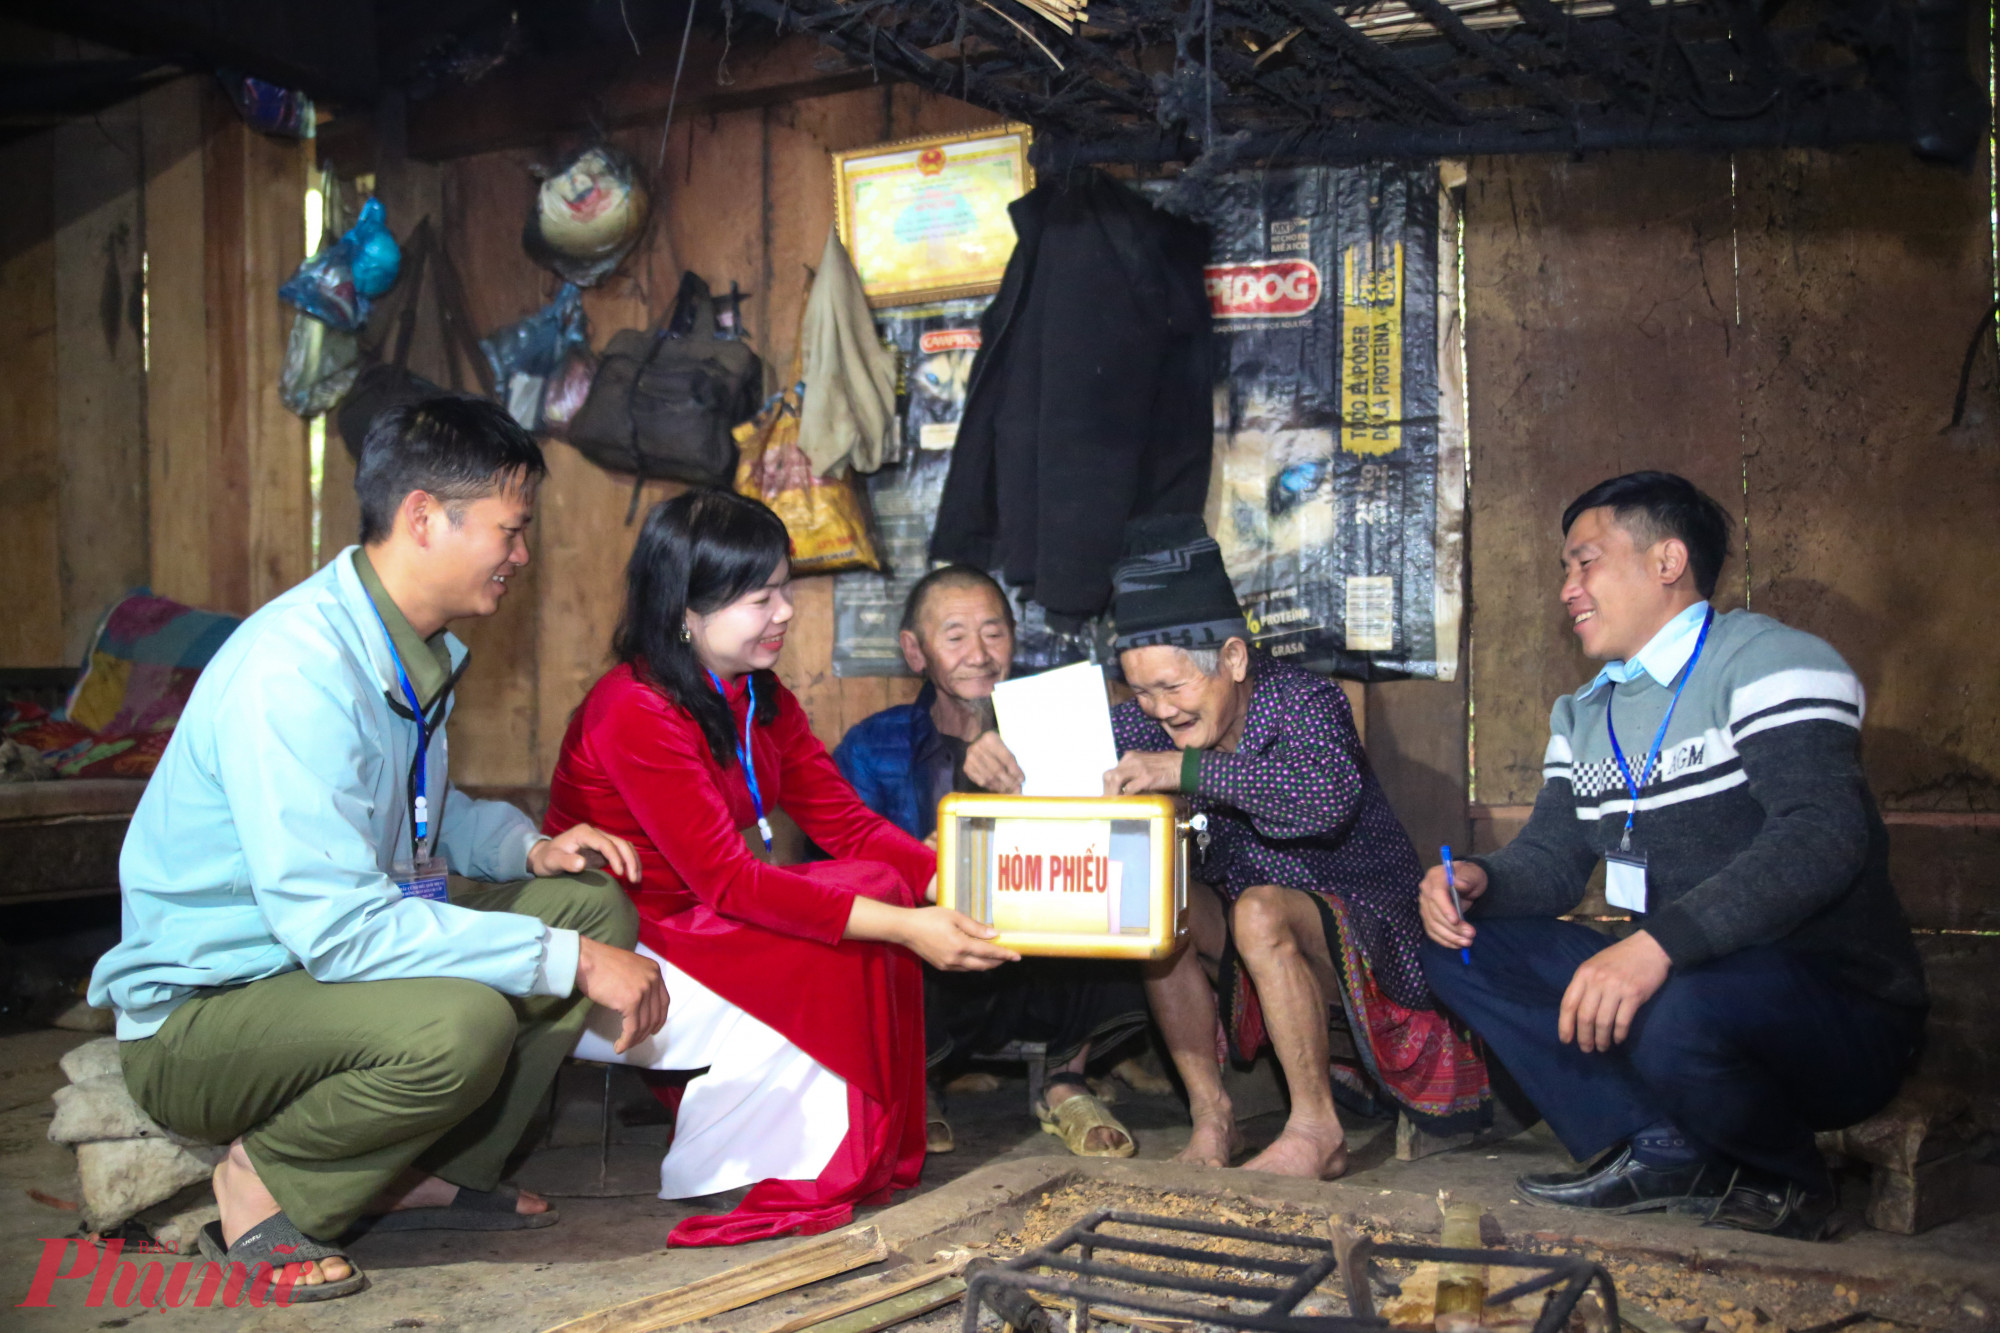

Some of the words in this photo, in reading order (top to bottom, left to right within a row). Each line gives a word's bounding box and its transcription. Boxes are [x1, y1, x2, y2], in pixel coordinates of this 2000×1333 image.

[1377, 267, 1394, 301] 10%
[1351, 325, 1370, 376] PODER
[1271, 641, 1306, 658] GRASA
[1667, 743, 1706, 775] AGM
[998, 846, 1042, 892] HÒM
[1049, 843, 1108, 893] PHIẾU
